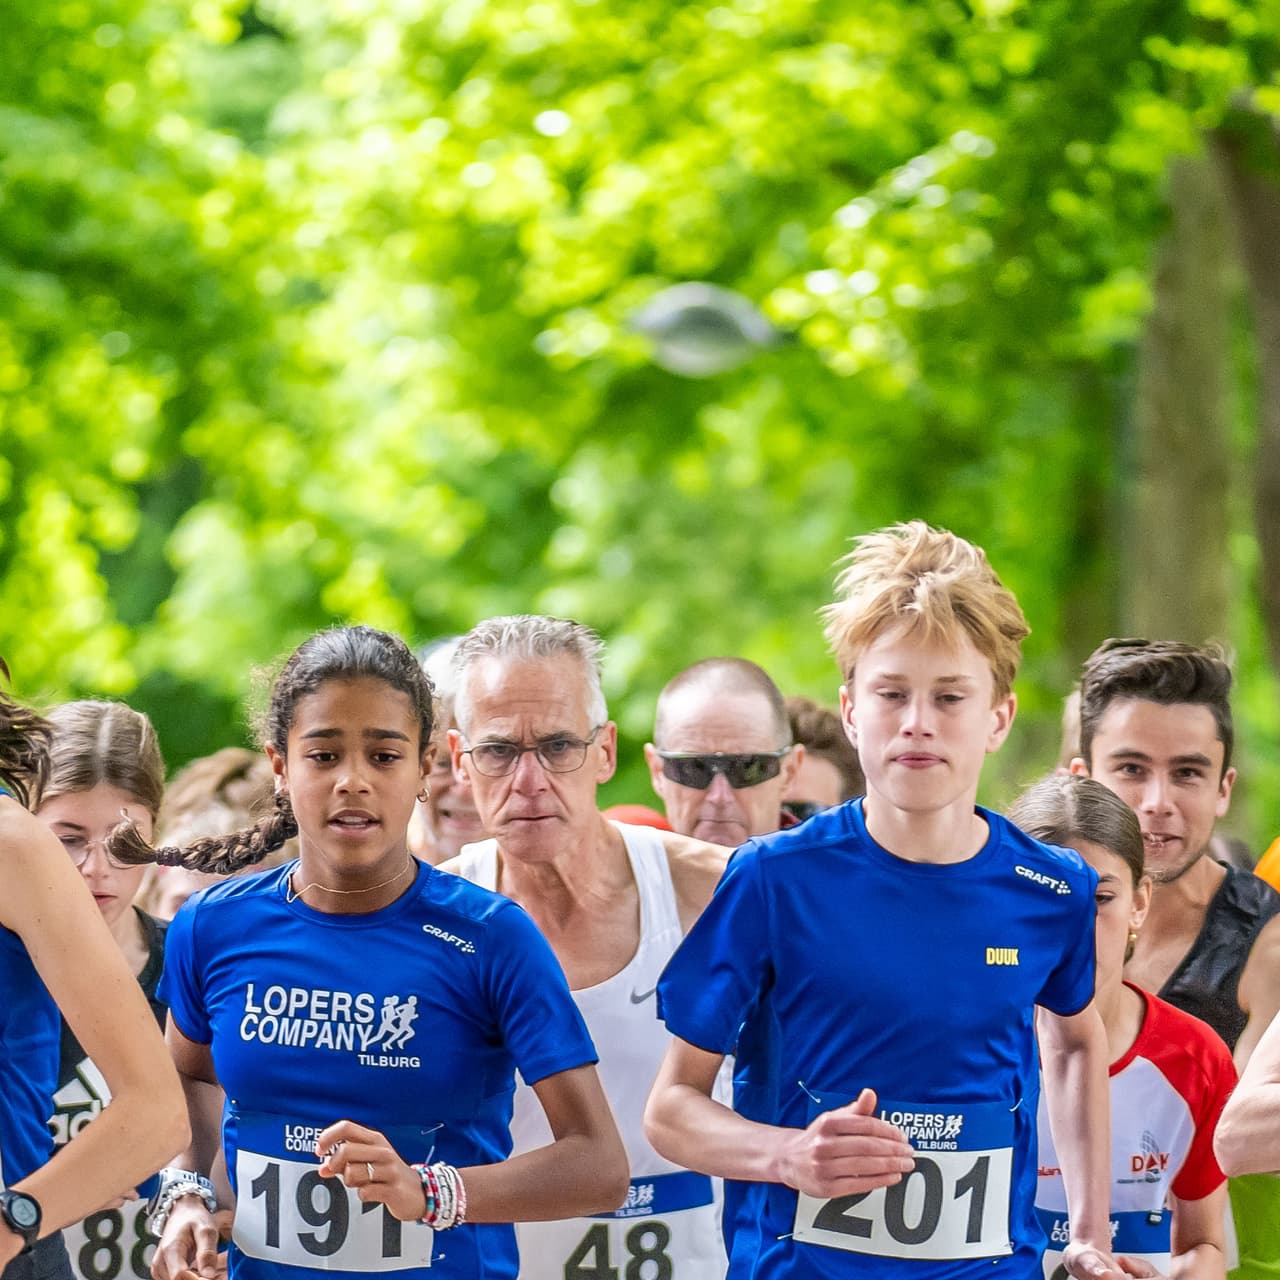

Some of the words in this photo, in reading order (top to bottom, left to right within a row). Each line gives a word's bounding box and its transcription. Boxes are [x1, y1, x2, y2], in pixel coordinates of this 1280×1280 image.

[1015, 865, 1059, 889] CRAFT
[423, 924, 466, 946] CRAFT
[986, 947, 1019, 966] DUUK
[245, 983, 375, 1023] LOPERS
[240, 1013, 373, 1051] COMPANY
[358, 1054, 420, 1067] TILBURG
[881, 1110, 944, 1127] LOPERS
[285, 1125, 322, 1140] LOPE
[916, 1140, 958, 1150] TILBURG
[251, 1162, 402, 1258] 191
